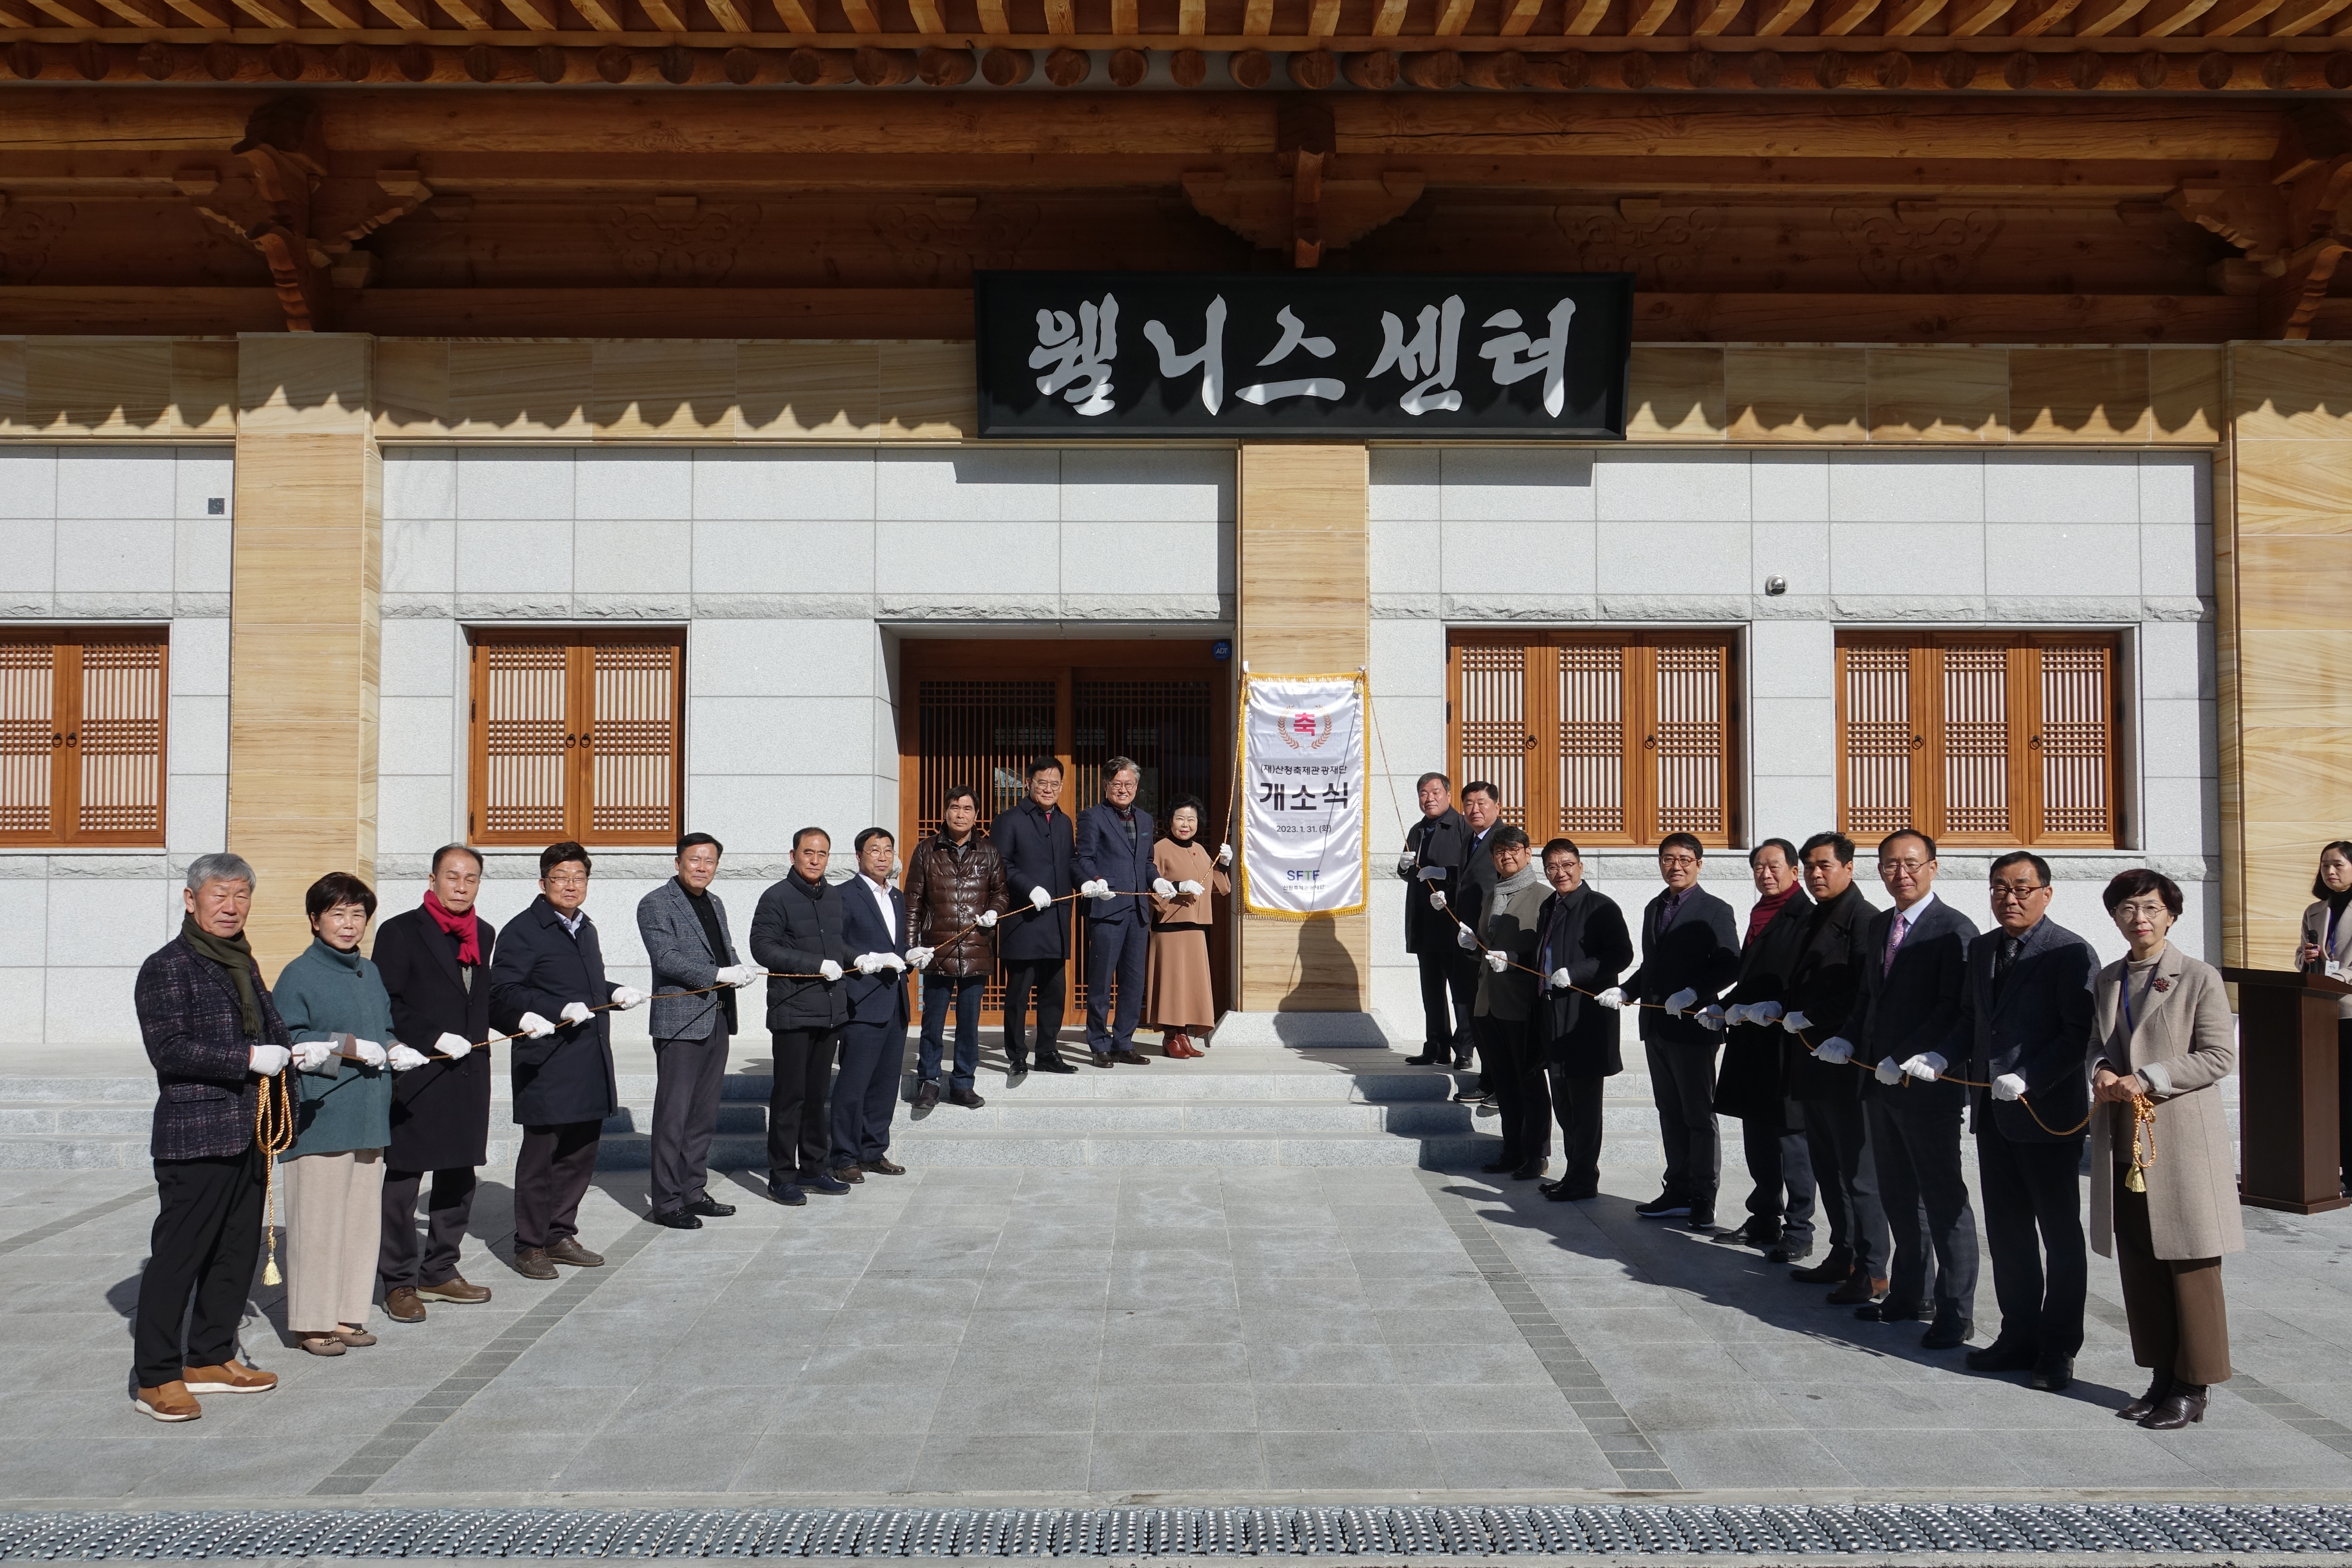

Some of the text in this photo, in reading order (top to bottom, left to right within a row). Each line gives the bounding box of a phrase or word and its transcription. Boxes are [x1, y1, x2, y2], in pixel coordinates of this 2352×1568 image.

[1029, 293, 1576, 418] 웰니스센터
[1293, 712, 1316, 736] 축
[1261, 764, 1348, 775] (재)산청축제관광재단
[1259, 782, 1348, 811] 개소식
[1319, 824, 1332, 833] (화)
[1287, 870, 1320, 881] SFTF
